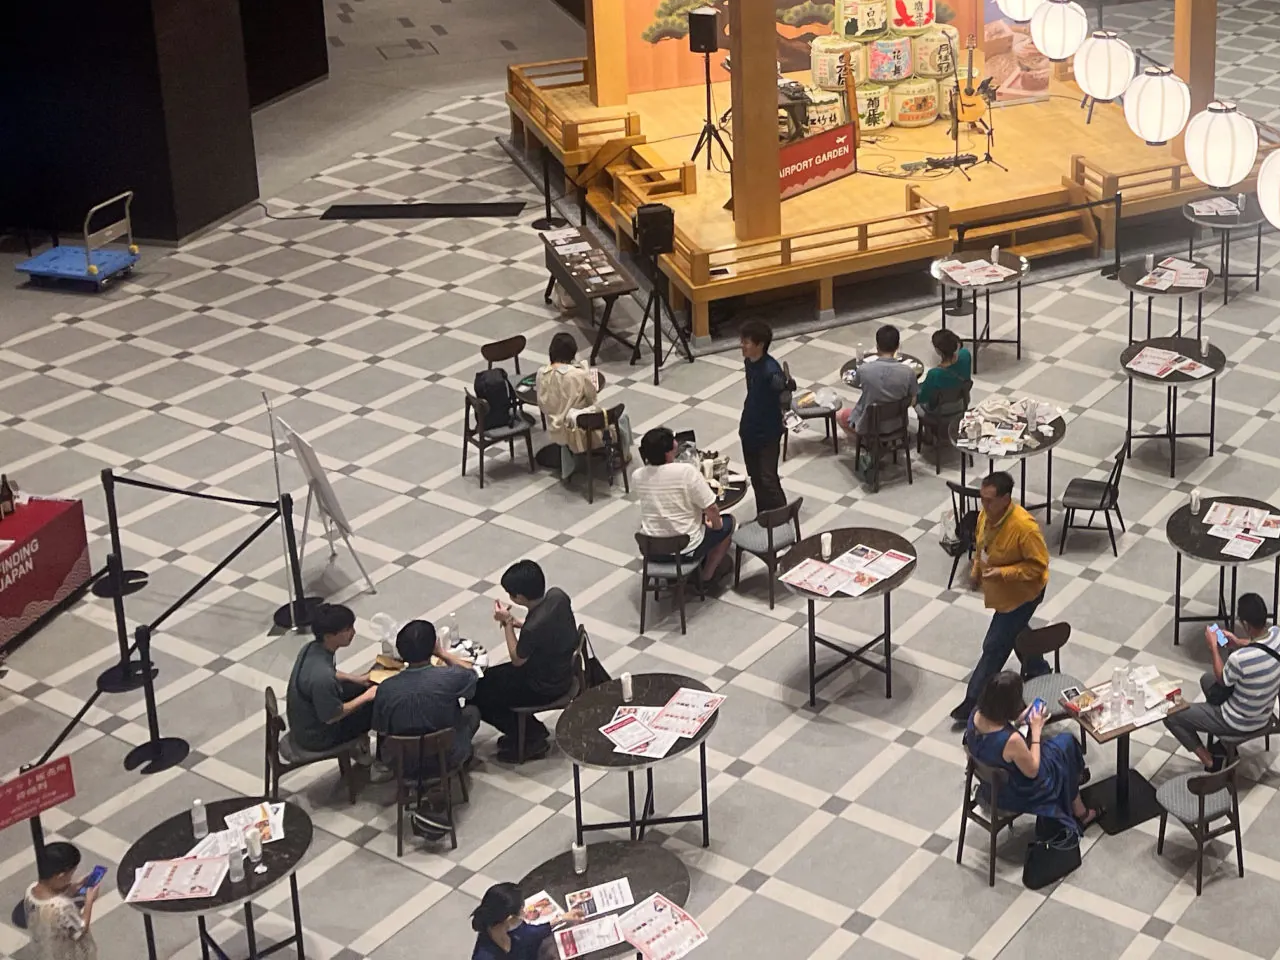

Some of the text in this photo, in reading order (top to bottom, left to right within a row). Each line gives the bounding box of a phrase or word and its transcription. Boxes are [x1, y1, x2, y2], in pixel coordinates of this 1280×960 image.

[815, 145, 849, 165] GARDEN
[0, 539, 40, 575] INDING
[0, 557, 34, 592] JAPAN
